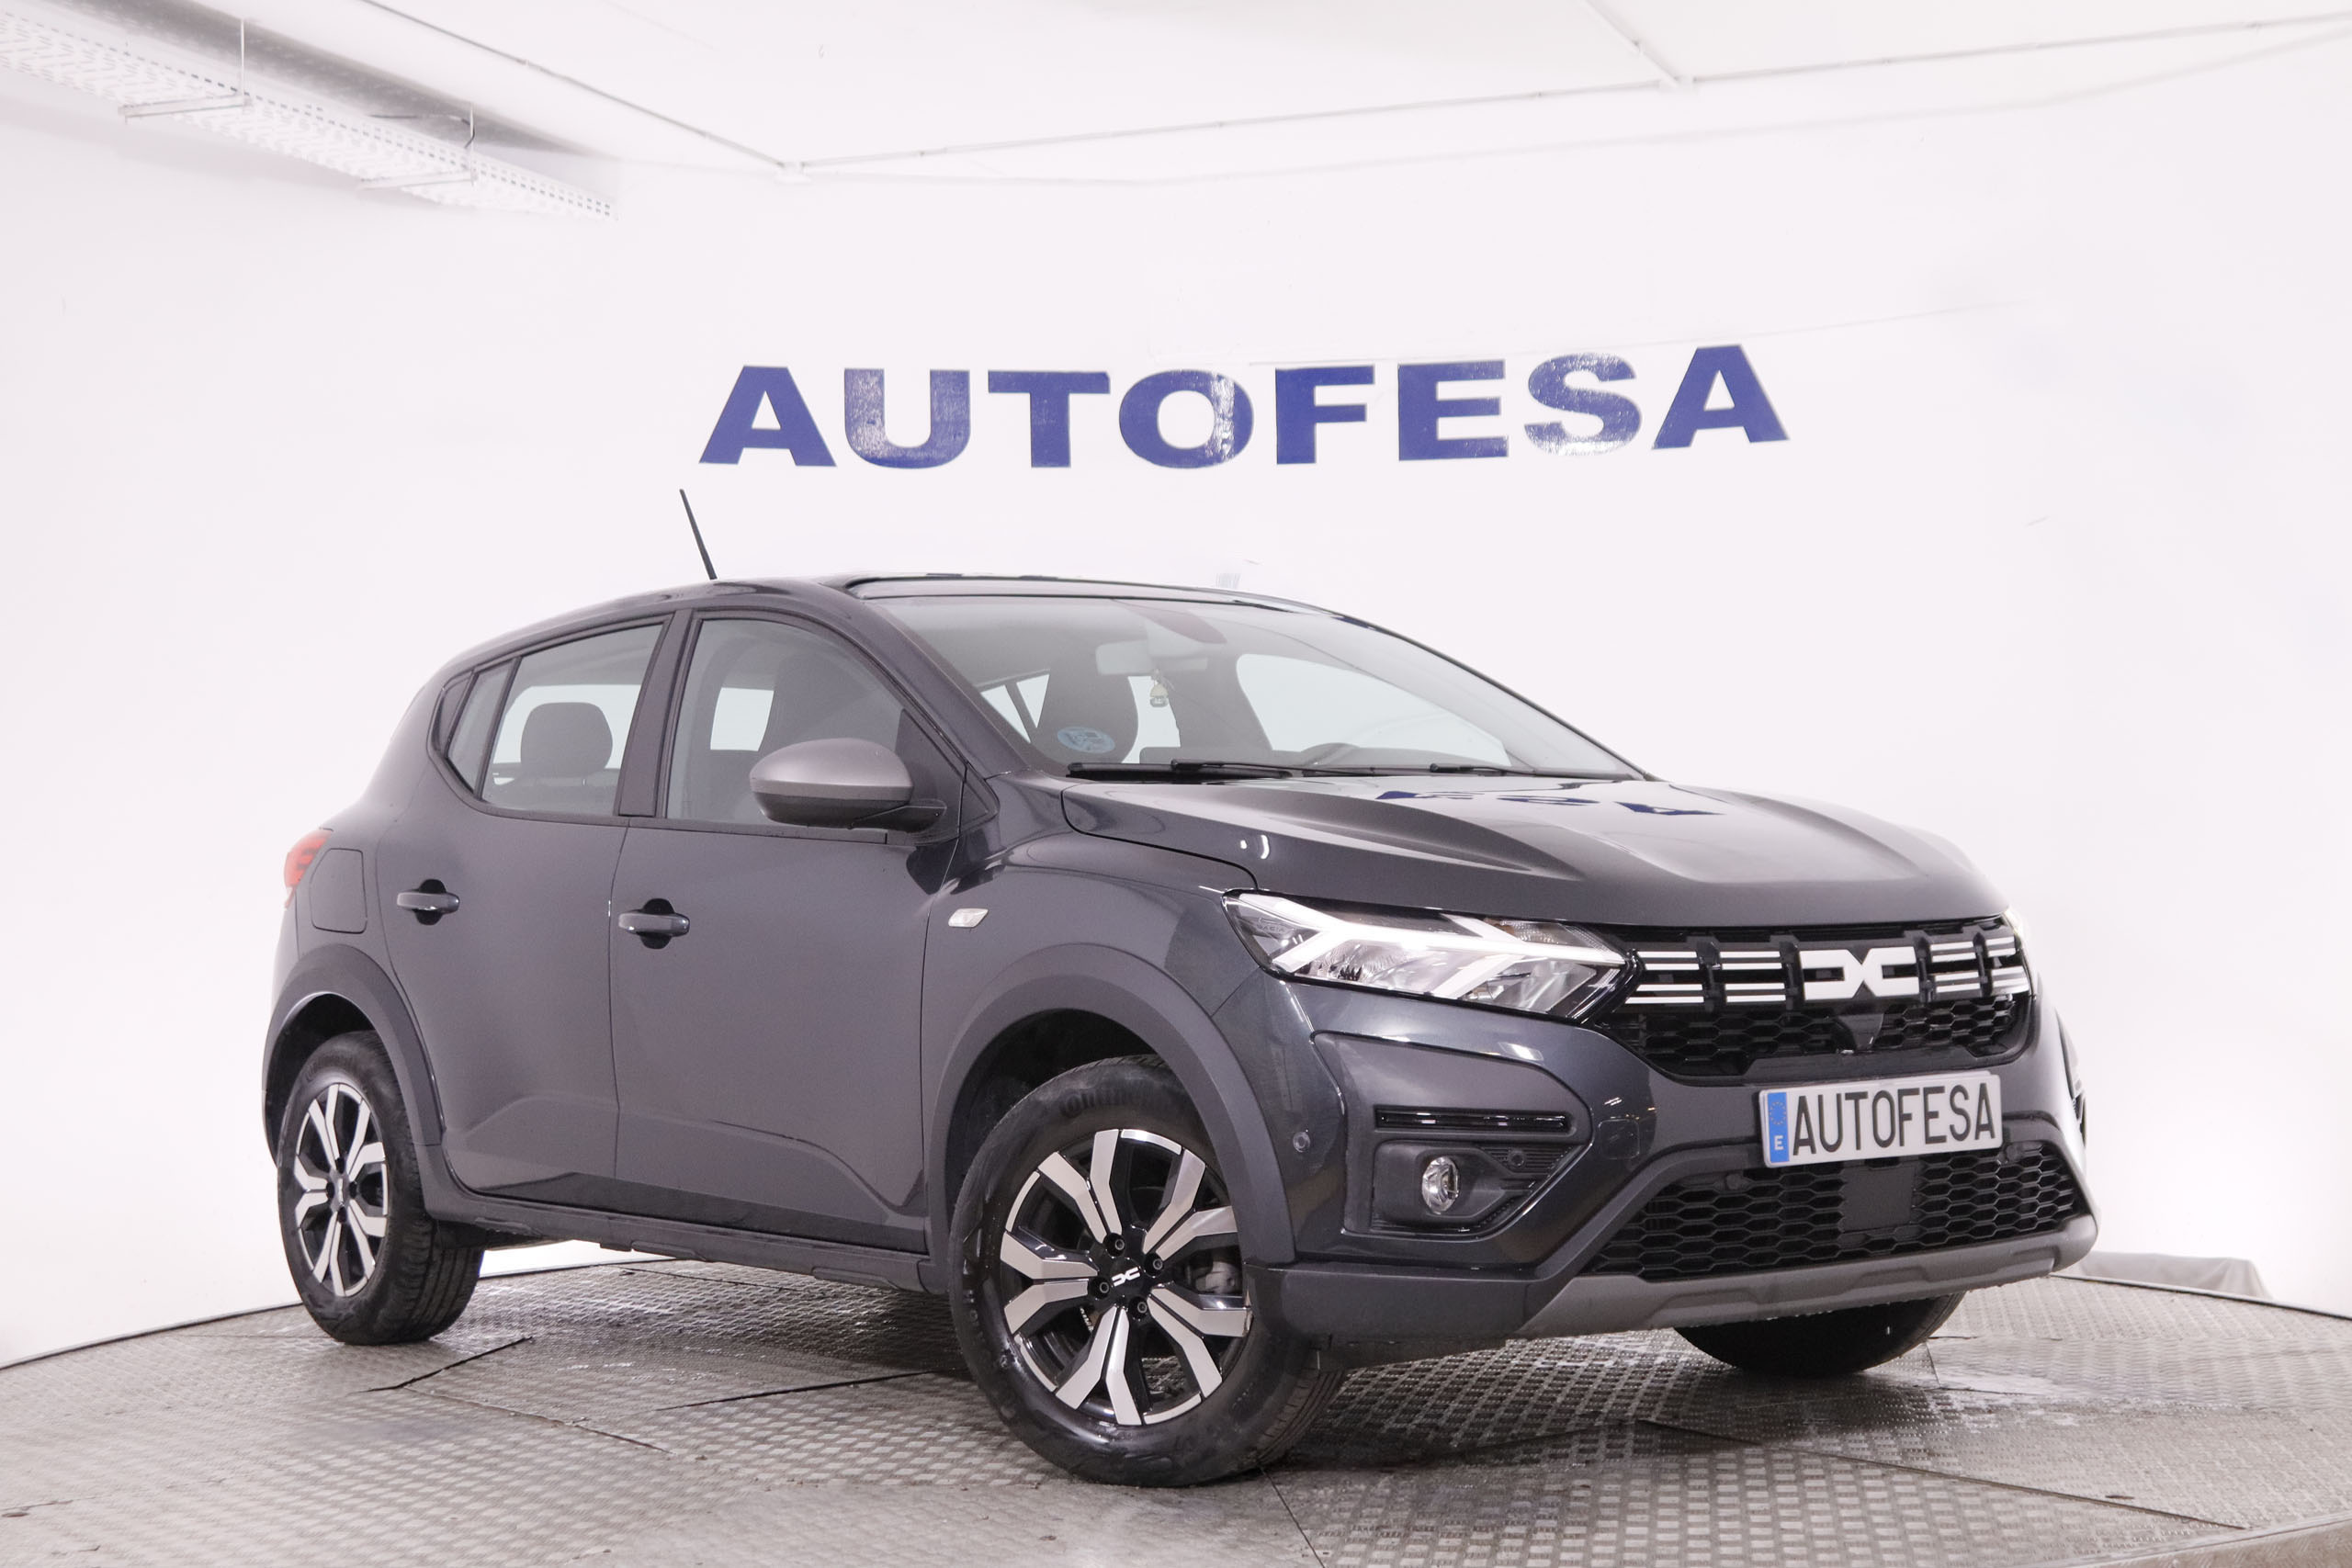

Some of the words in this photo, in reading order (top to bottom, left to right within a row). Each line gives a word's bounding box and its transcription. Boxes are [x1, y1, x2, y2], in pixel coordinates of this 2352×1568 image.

[699, 344, 1790, 469] AUTOFESA
[1773, 1135, 1784, 1151] E
[1792, 1082, 1996, 1156] AUTOFESA
